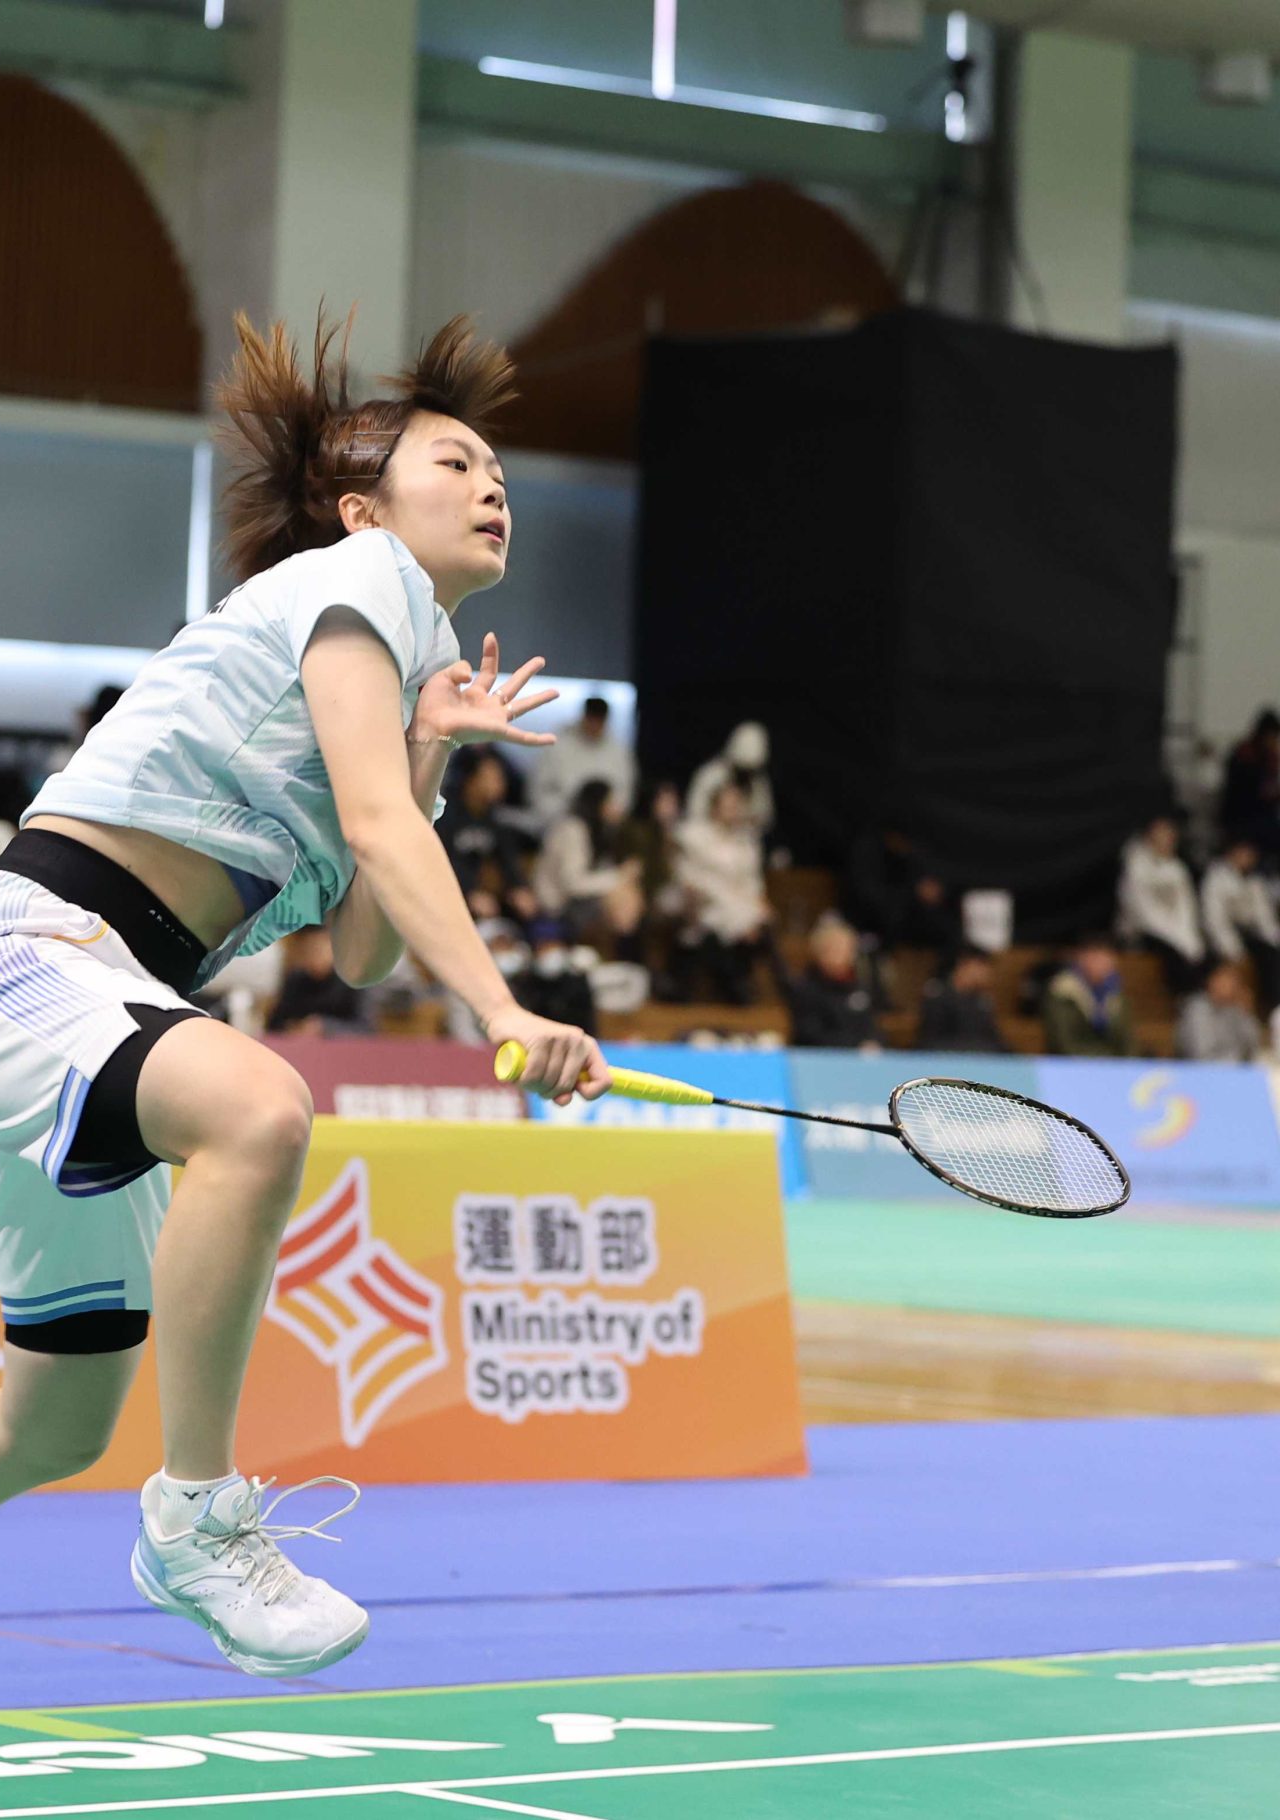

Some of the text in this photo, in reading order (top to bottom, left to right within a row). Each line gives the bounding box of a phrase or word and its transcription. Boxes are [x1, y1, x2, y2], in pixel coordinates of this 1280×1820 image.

[462, 1206, 652, 1274] 運動部
[470, 1299, 697, 1352] Ministry of
[475, 1360, 620, 1406] Sports
